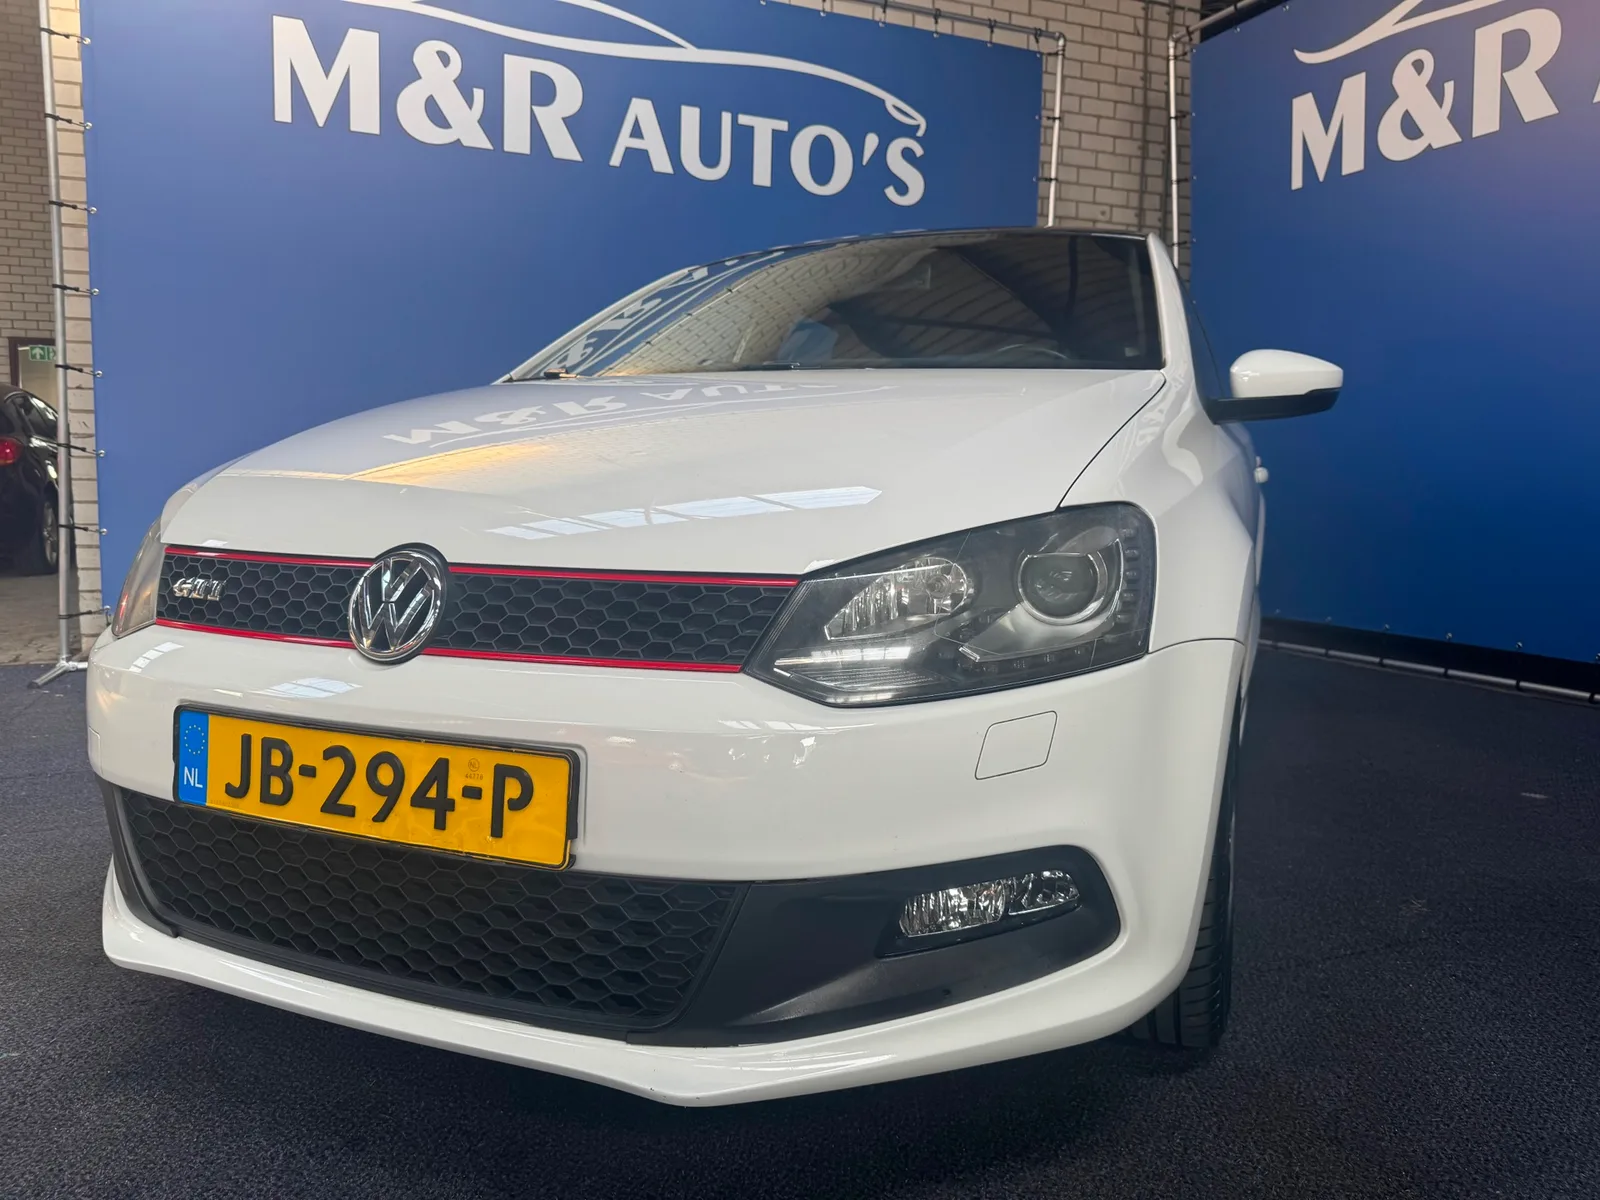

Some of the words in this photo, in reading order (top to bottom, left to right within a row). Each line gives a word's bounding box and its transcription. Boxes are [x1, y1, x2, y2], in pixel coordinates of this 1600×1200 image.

[271, 15, 583, 162] M&R
[609, 97, 925, 207] AUTO'S
[1290, 8, 1562, 191] M&R
[184, 766, 203, 788] NL
[225, 733, 534, 838] JB-294-P
